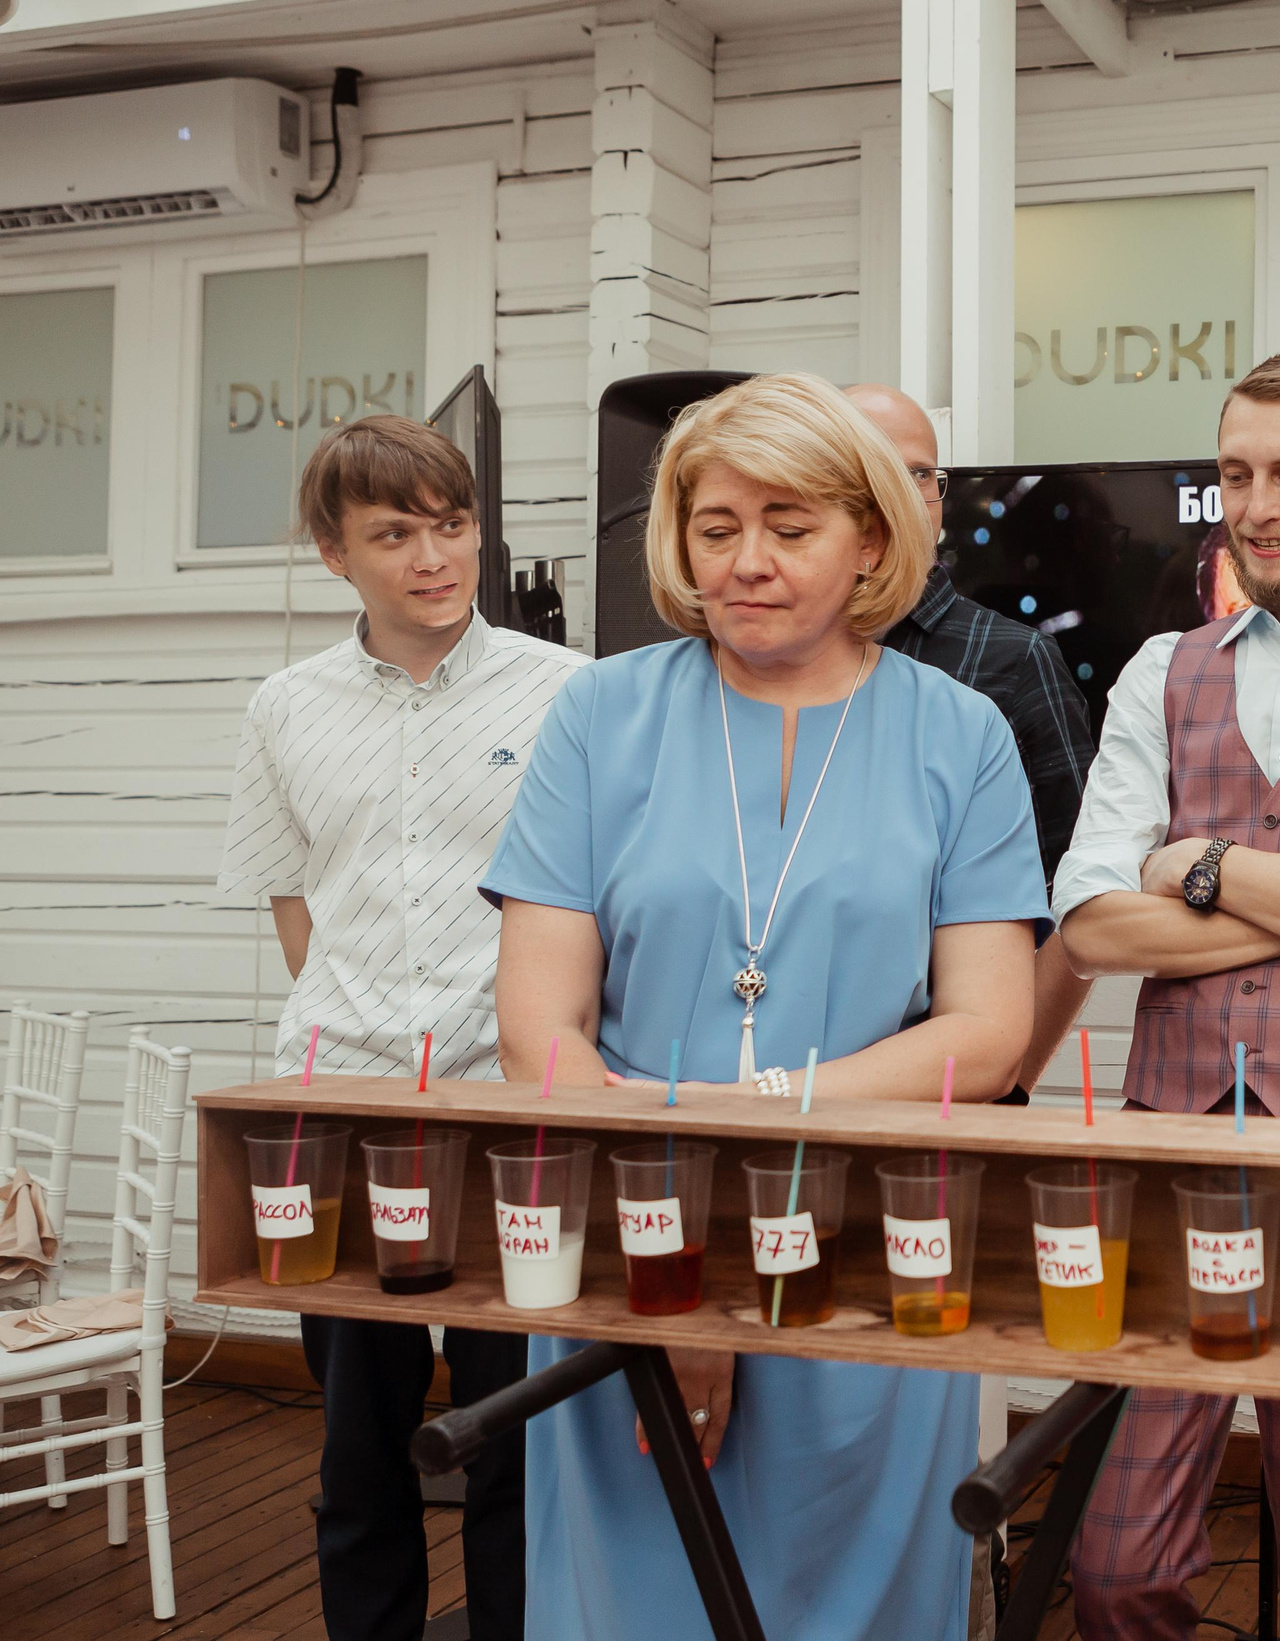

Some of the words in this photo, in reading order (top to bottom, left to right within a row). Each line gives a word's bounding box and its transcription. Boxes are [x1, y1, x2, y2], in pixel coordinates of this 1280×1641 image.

[0, 397, 104, 449] DKI
[229, 371, 415, 434] DUDKI
[498, 1209, 543, 1230] ТАН
[754, 1224, 811, 1260] 777
